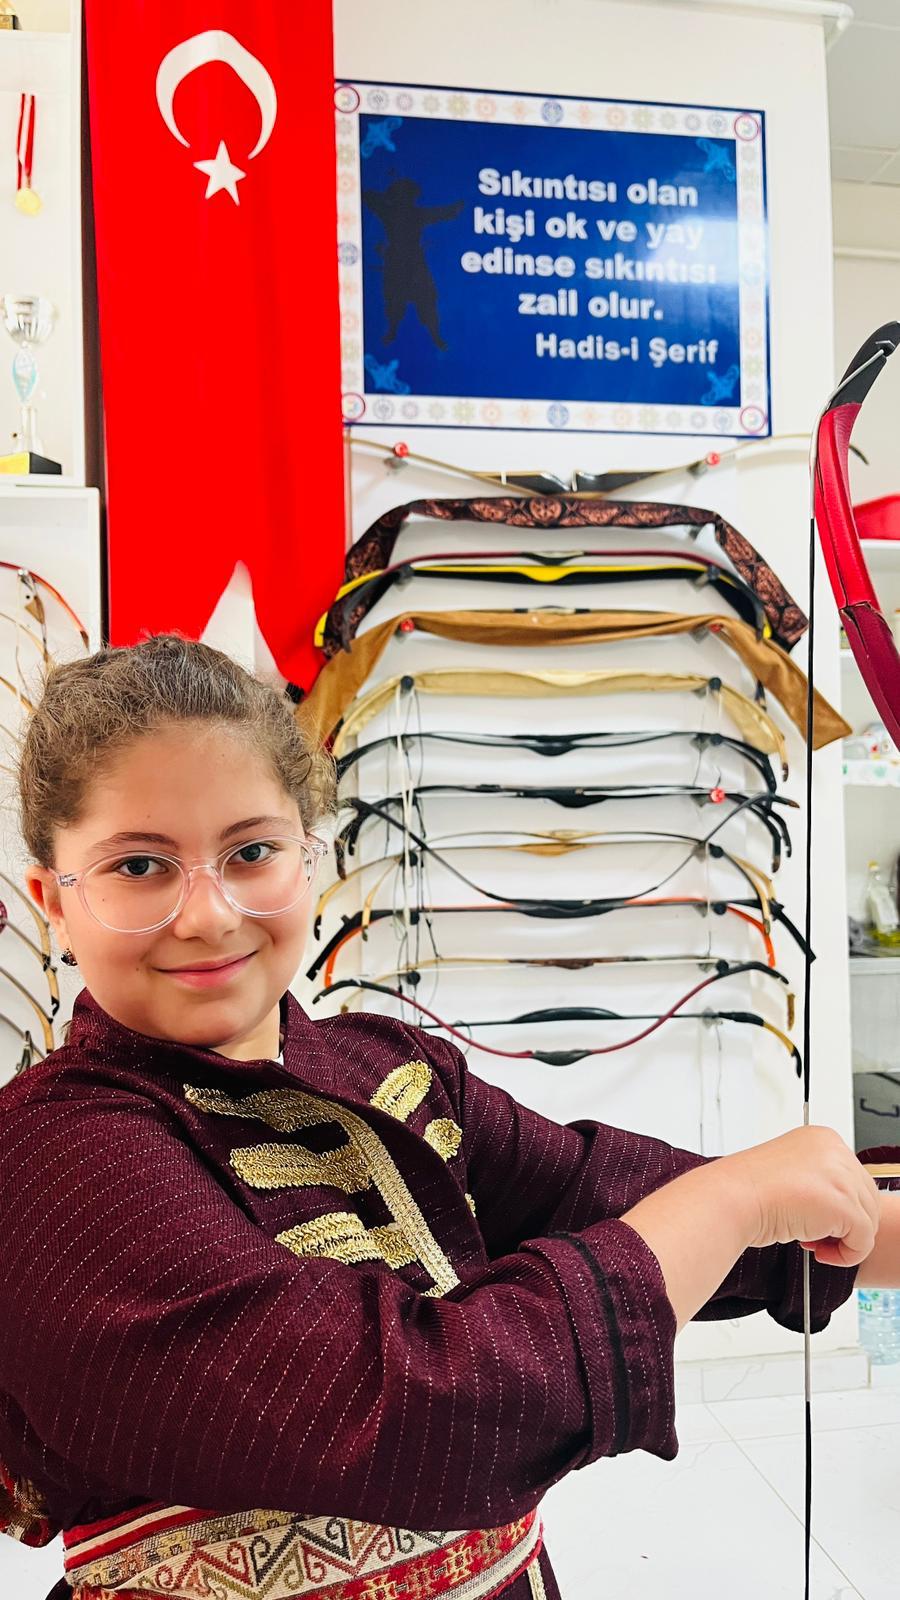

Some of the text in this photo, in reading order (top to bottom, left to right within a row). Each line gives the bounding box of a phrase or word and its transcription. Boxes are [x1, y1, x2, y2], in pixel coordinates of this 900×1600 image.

[478, 168, 699, 207] Sıkıntısı olan
[473, 206, 704, 249] kişi ok ve yay
[460, 247, 717, 284] edinse sıkıntısı
[517, 288, 664, 320] zail olur.
[535, 332, 719, 368] Hadis-i Şerif
